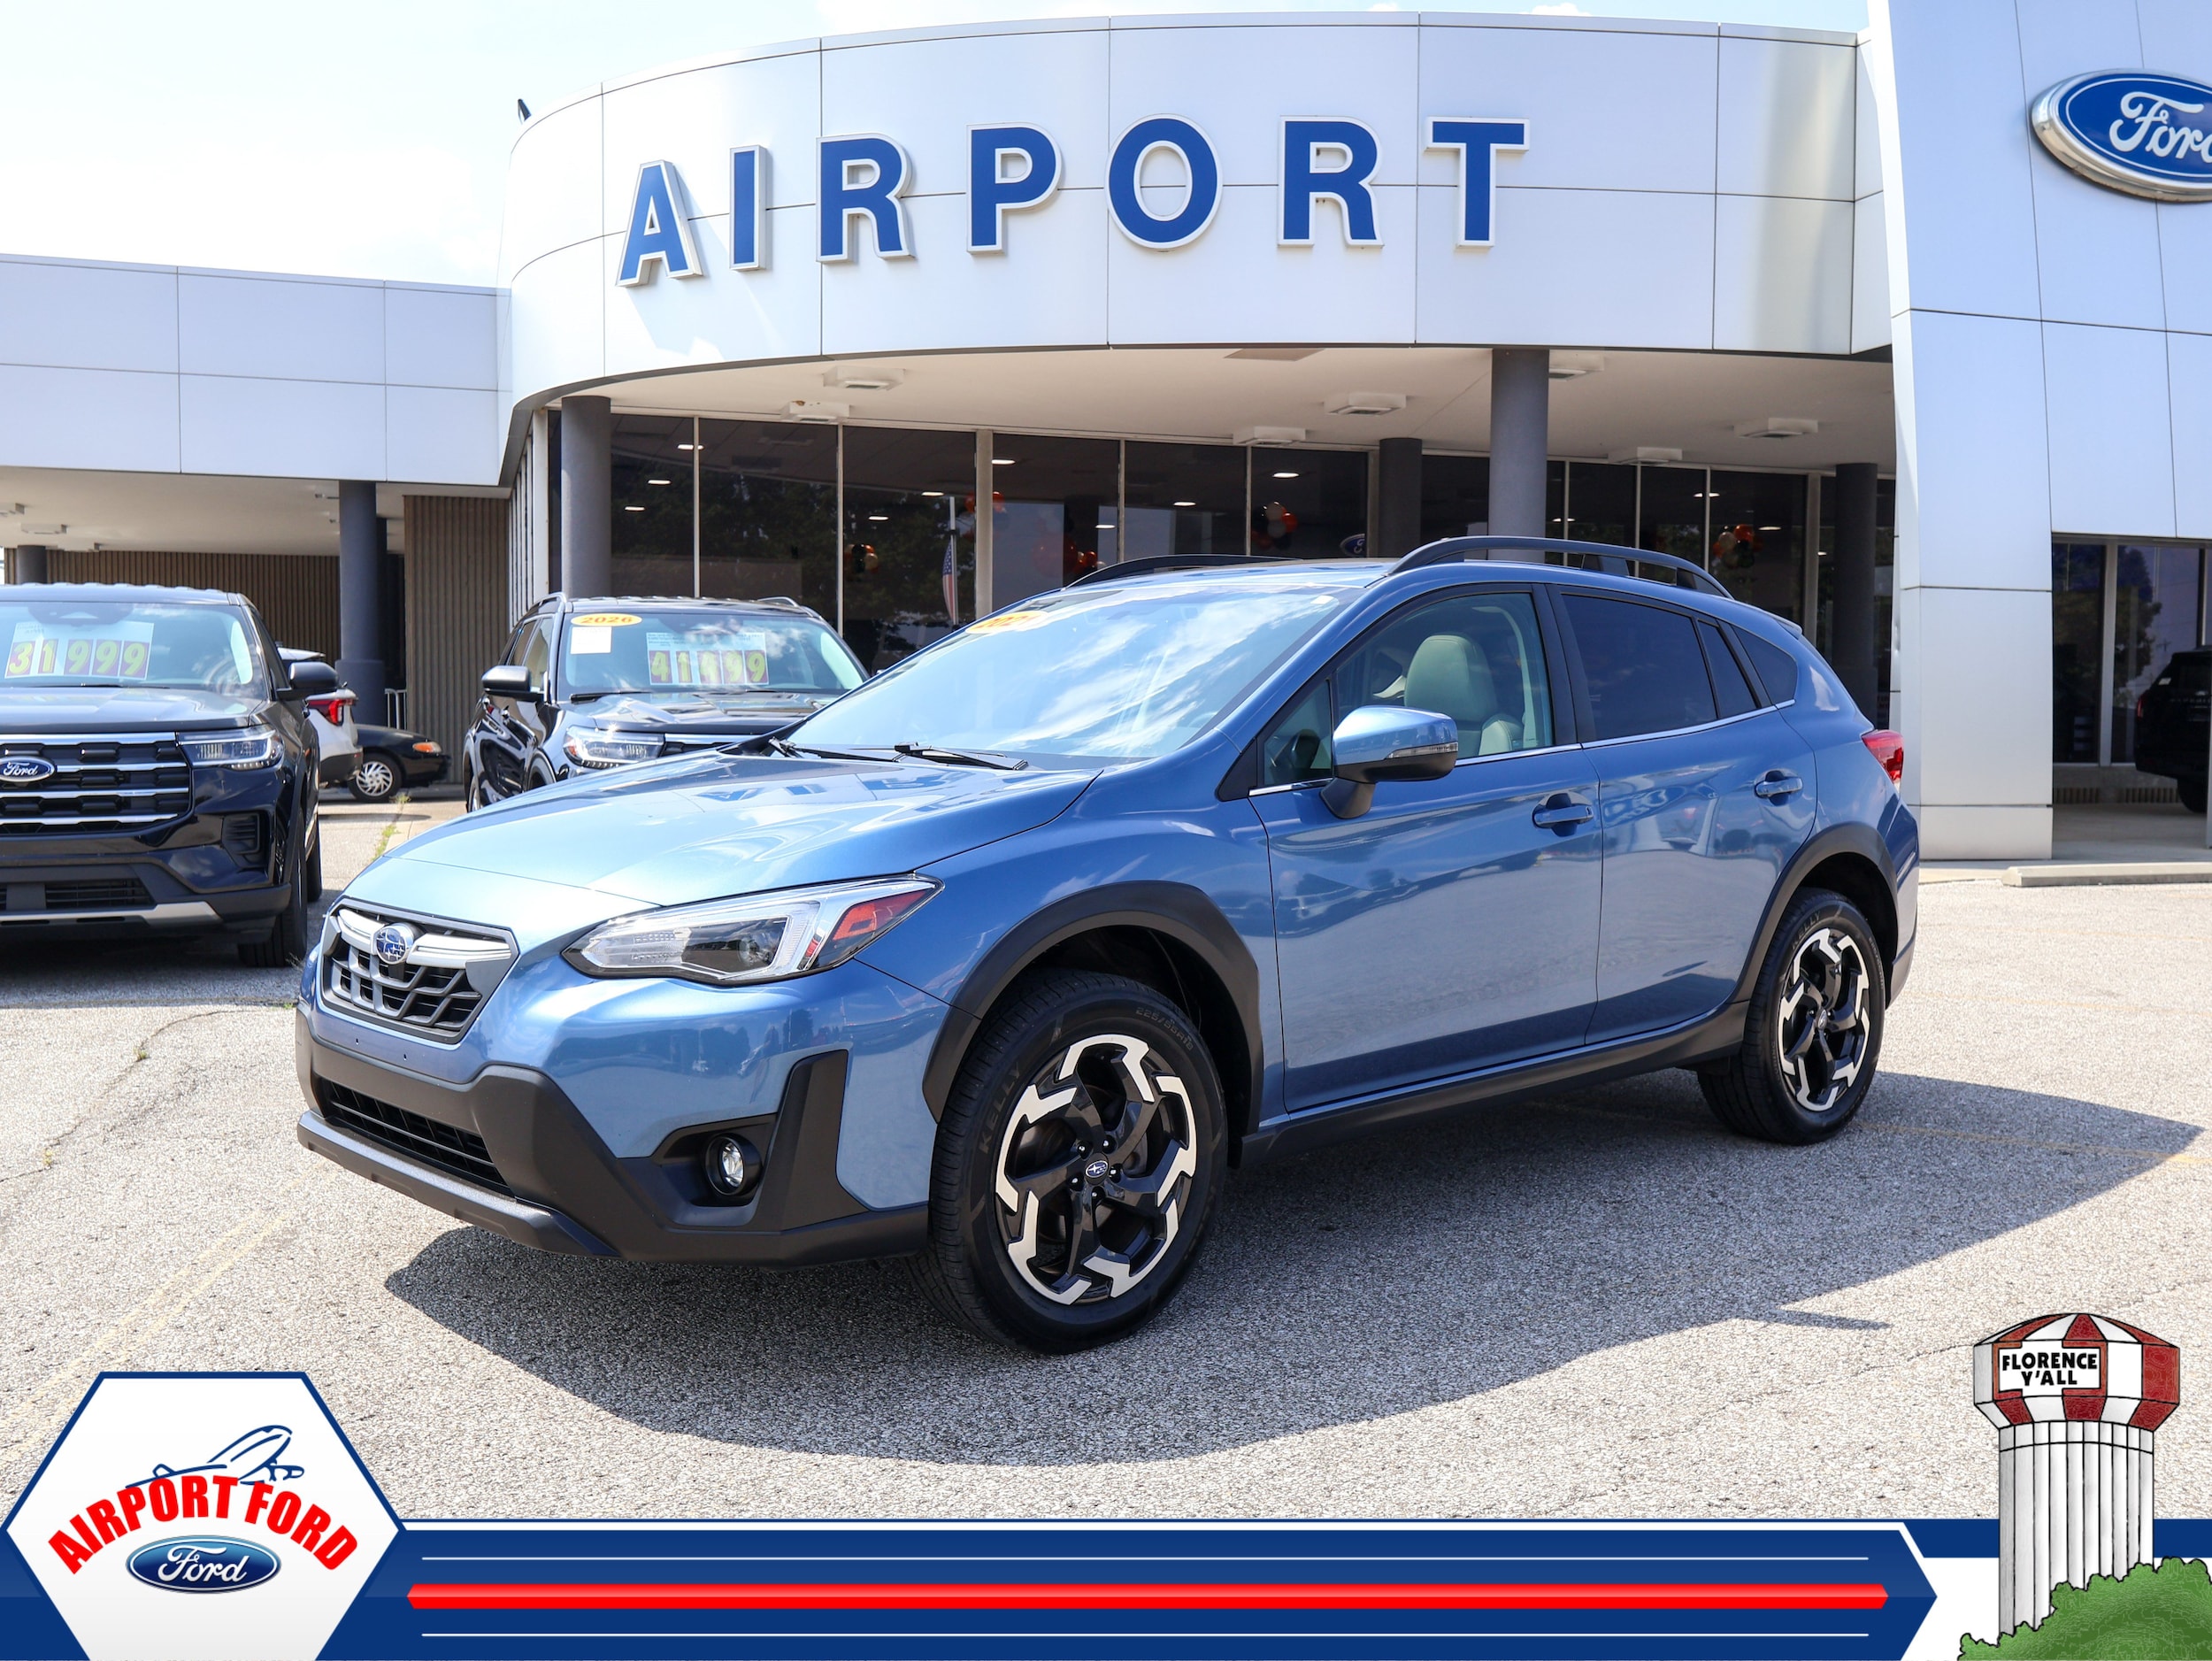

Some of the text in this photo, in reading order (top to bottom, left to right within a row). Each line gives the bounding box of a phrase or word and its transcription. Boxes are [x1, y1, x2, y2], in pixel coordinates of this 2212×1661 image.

[615, 113, 1530, 288] AIRPORT
[9, 640, 146, 675] 31999
[4, 762, 39, 776] Ford
[978, 1061, 1020, 1154] KELLY
